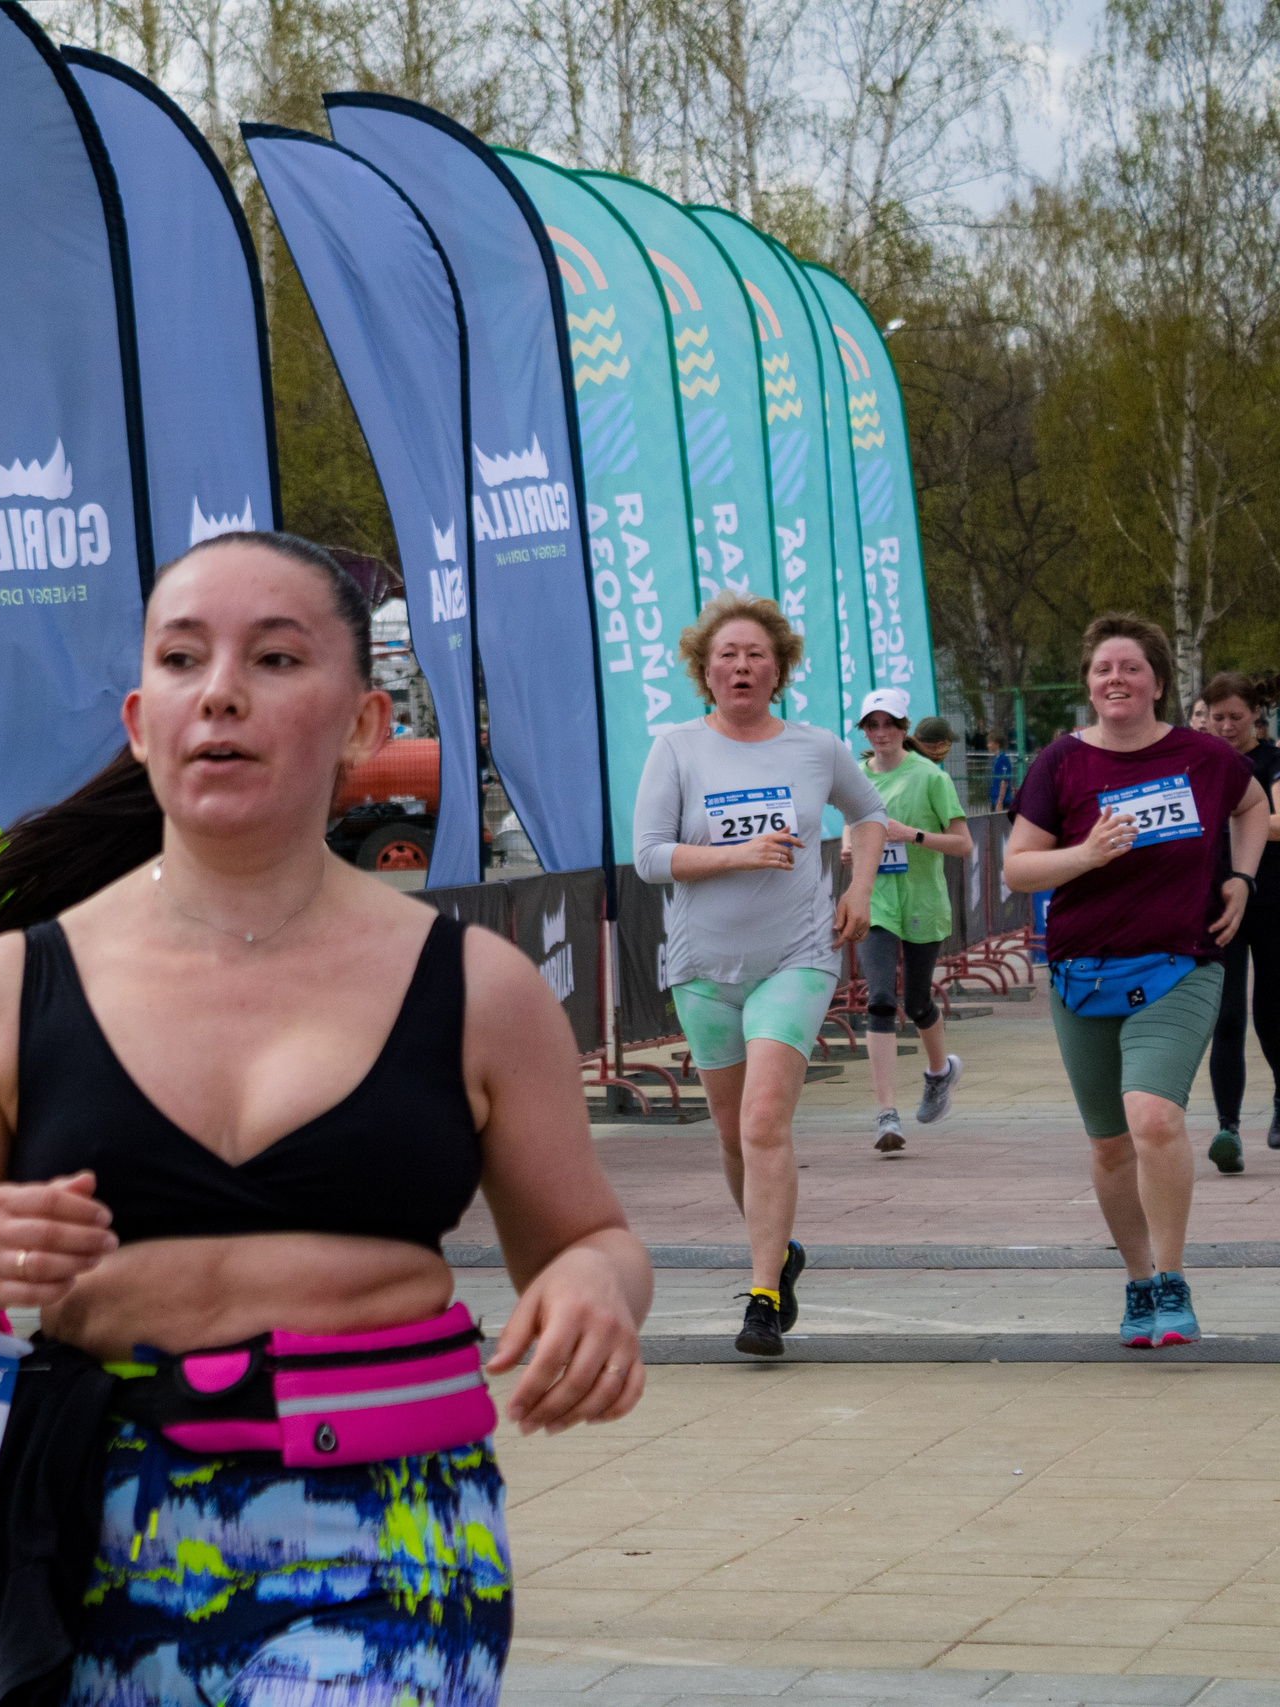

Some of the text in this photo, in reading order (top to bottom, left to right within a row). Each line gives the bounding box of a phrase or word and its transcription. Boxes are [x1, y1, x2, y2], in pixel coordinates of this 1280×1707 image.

[721, 813, 786, 839] 2376
[1125, 803, 1185, 829] 375
[883, 849, 897, 863] 71
